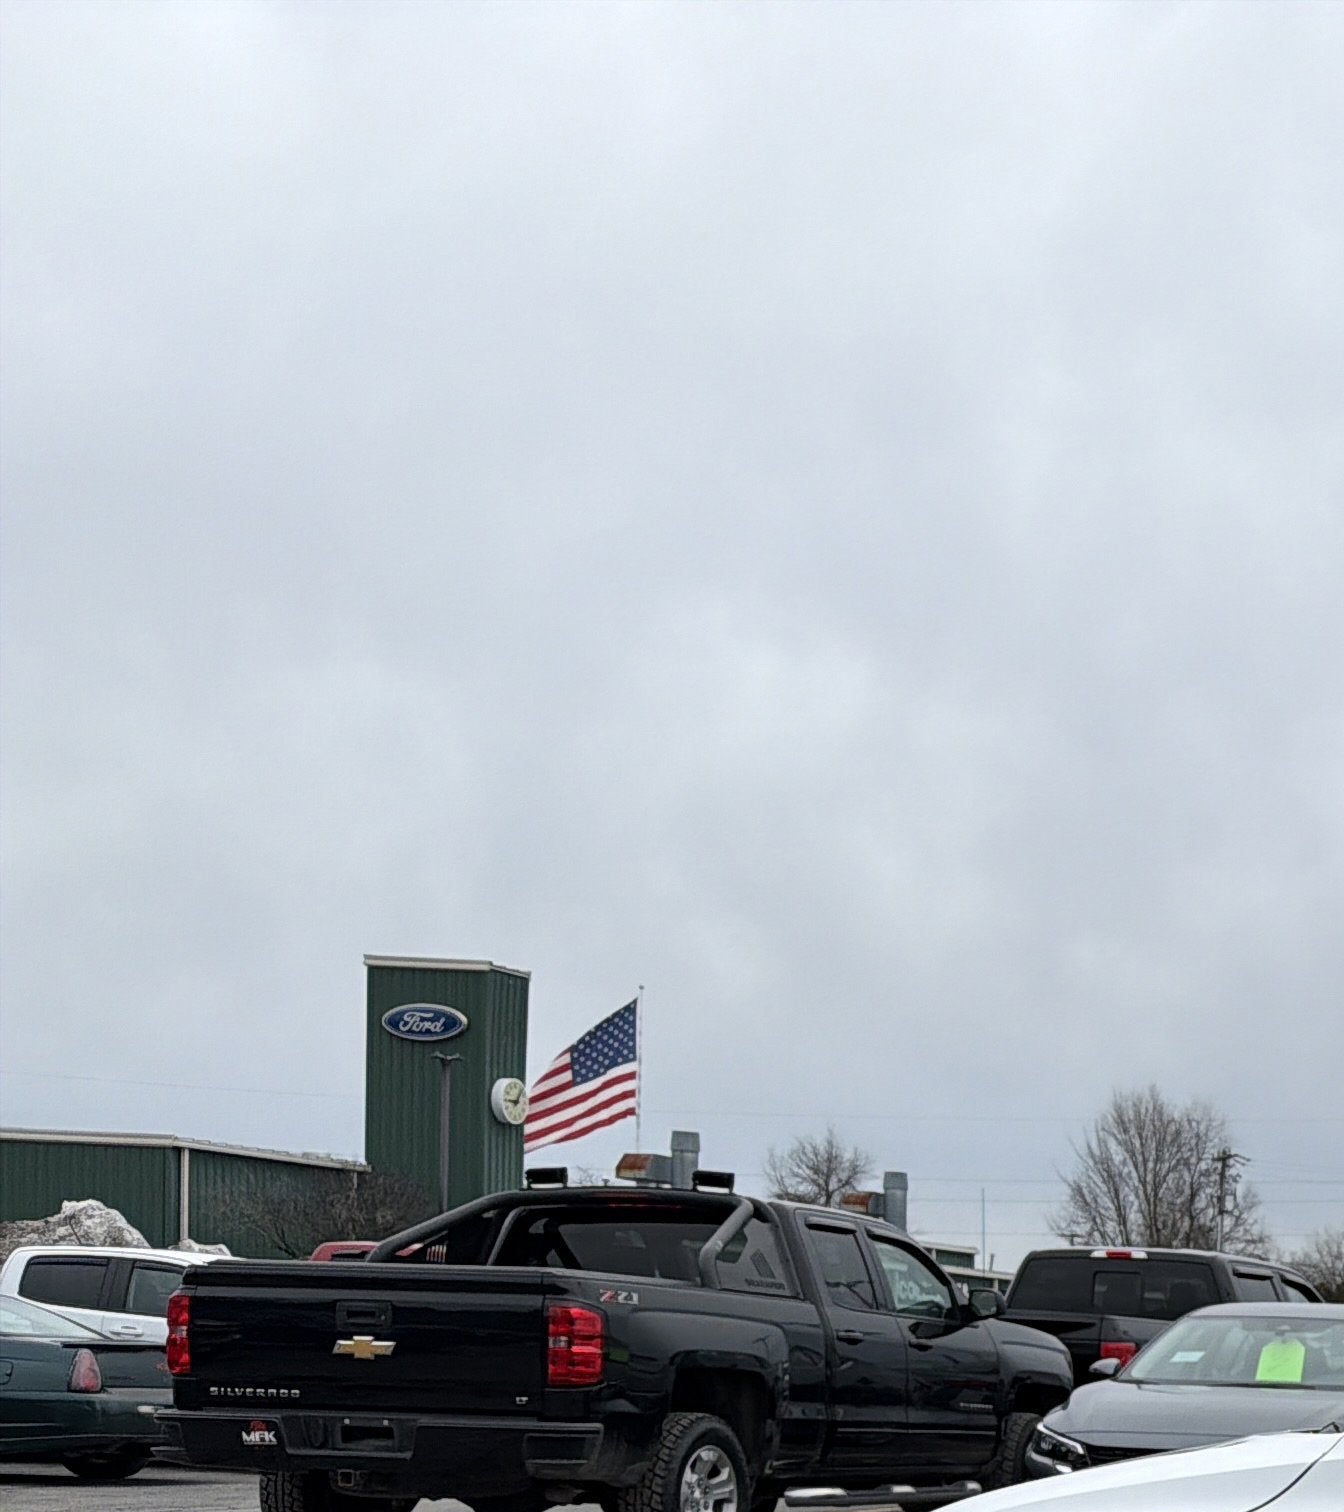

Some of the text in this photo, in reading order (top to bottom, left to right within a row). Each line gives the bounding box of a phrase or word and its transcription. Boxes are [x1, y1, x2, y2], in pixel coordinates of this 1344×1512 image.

[399, 1011, 446, 1033] Ford
[600, 1289, 639, 1305] Z71
[209, 1386, 300, 1398] SILVERADO
